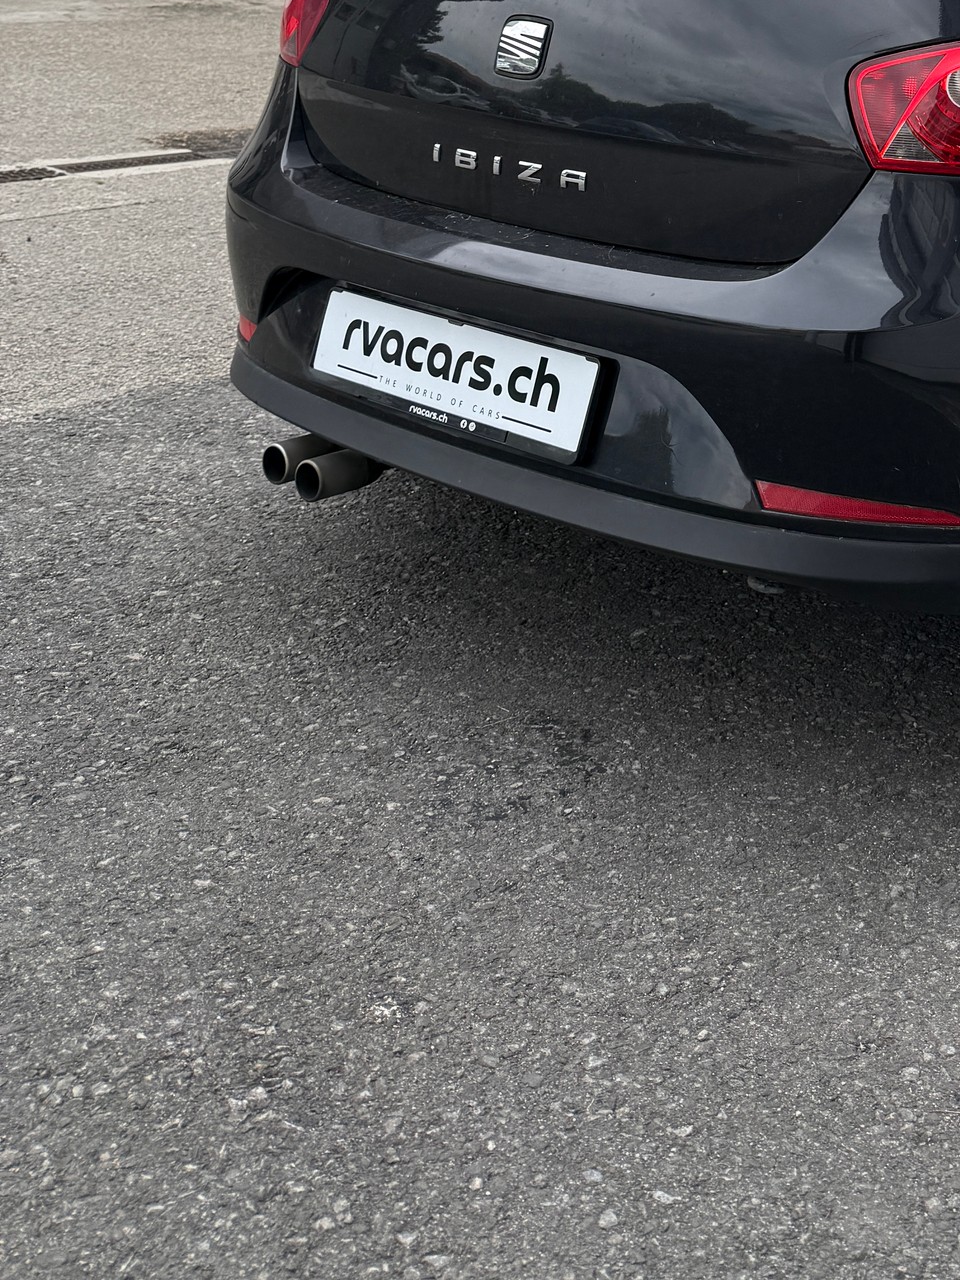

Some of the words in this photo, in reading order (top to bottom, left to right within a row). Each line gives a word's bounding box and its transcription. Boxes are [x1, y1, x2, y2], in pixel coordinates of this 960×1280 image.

[432, 143, 587, 192] IBIZA
[342, 318, 561, 413] rvacars.ch
[379, 375, 397, 388] THE
[405, 384, 442, 402] WORLD
[450, 398, 464, 408] OF
[472, 404, 500, 420] CARS
[408, 405, 448, 423] rvacars.ch
